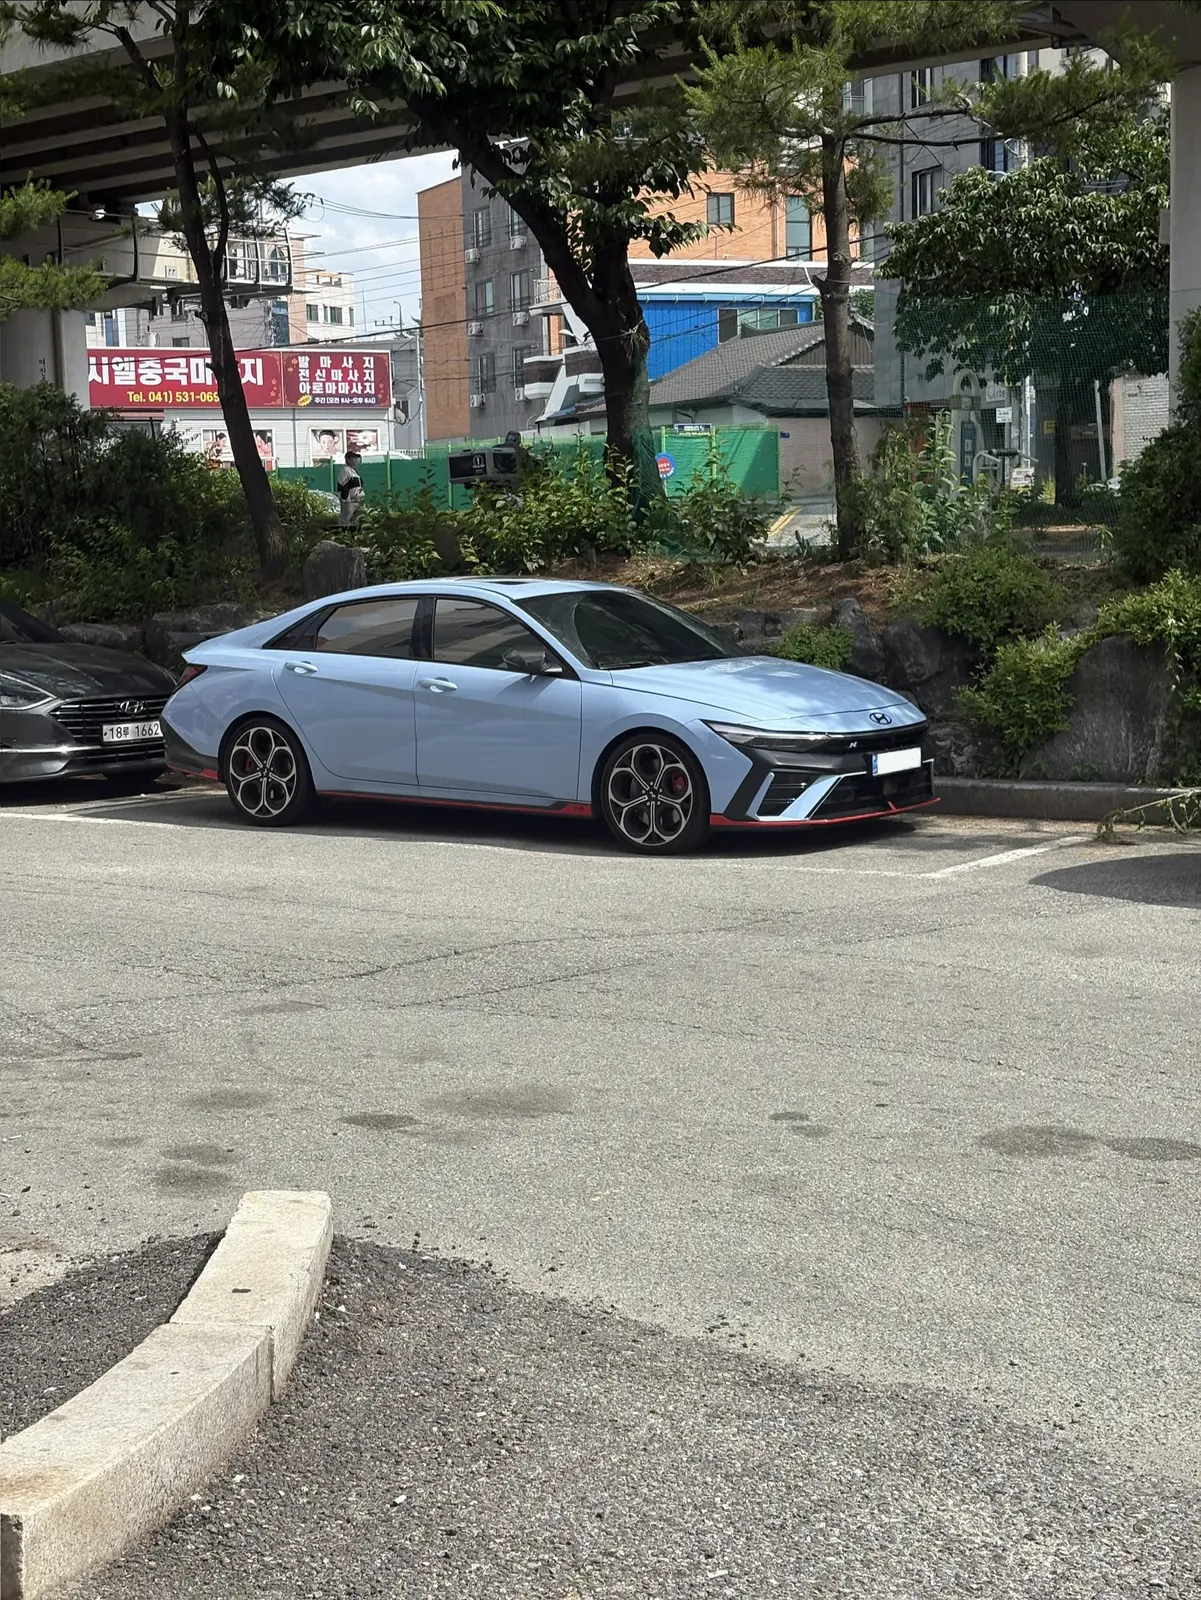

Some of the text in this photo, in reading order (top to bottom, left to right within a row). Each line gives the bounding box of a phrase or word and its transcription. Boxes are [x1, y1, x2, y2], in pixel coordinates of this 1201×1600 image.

[88, 356, 264, 386] 시엘중국마지
[127, 390, 220, 403] Tel. 041) 531-069
[135, 723, 160, 737] 1662
